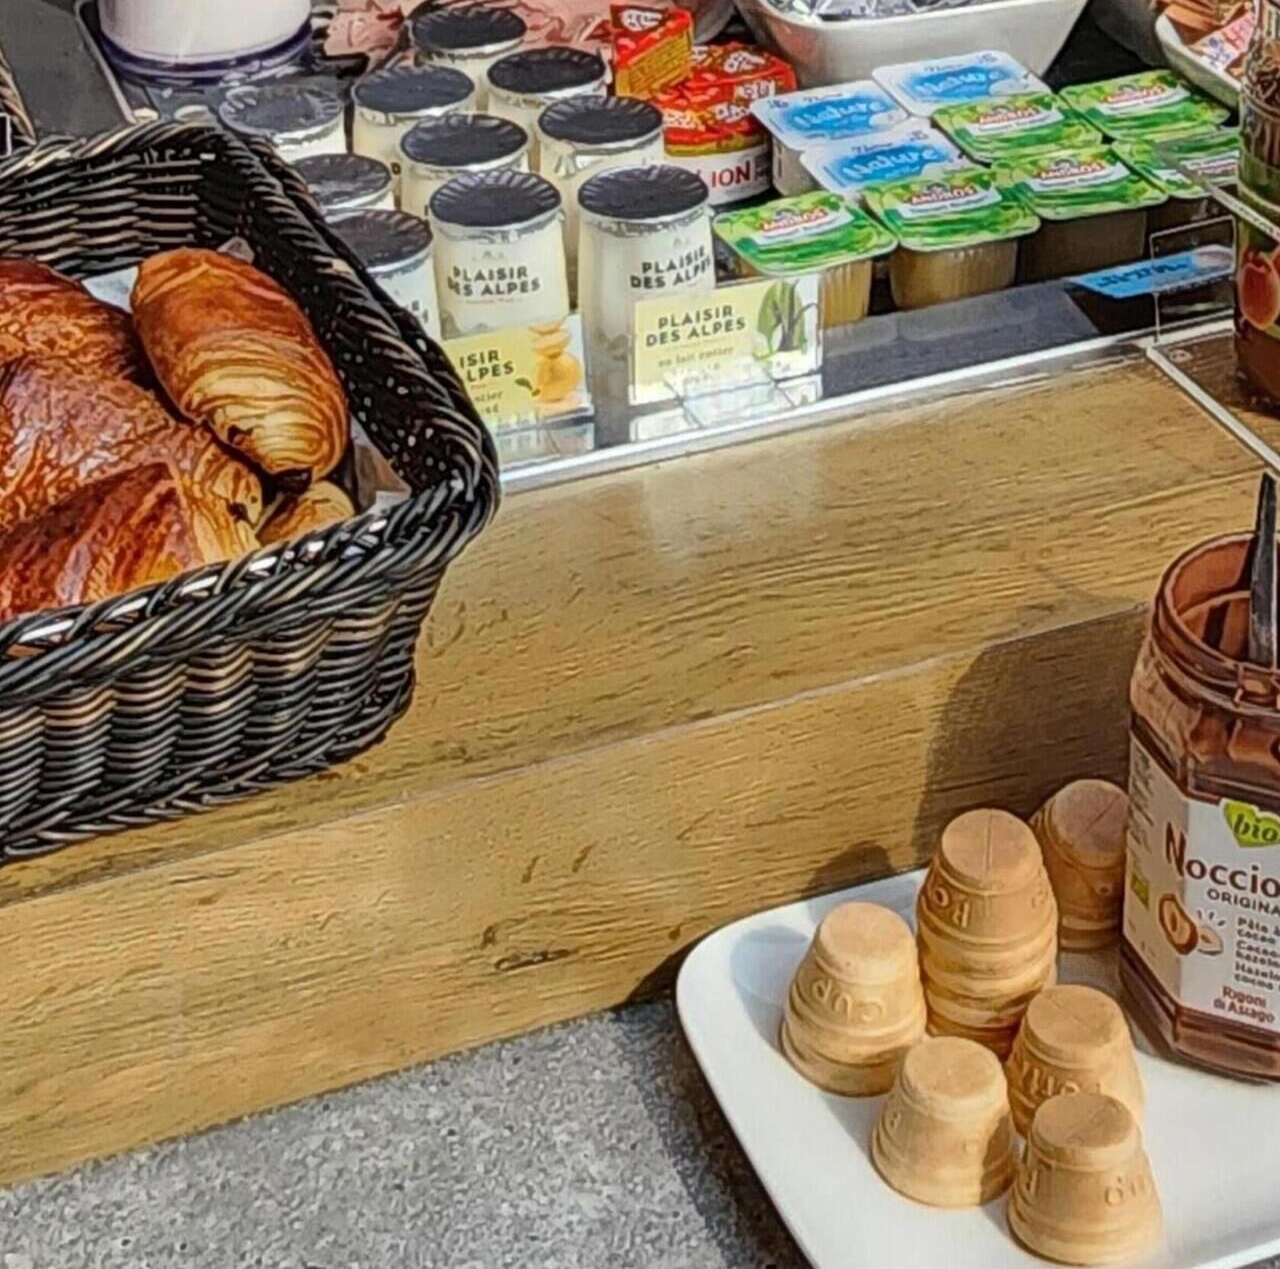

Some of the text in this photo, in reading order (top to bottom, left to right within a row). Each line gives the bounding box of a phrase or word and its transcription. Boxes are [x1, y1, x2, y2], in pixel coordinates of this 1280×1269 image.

[710, 160, 751, 188] ION
[841, 148, 938, 180] Nature
[452, 265, 528, 282] PLAISIR
[630, 274, 666, 289] DES
[480, 277, 541, 297] ALPES
[658, 305, 734, 330] PLAISIR
[645, 330, 681, 348] DES
[687, 317, 747, 341] ALPES
[459, 350, 500, 370] ISIR
[466, 361, 514, 382] LPES
[1233, 813, 1278, 842] bio
[1222, 985, 1267, 1008] Rigoni
[1228, 1001, 1276, 1023] Asiago
